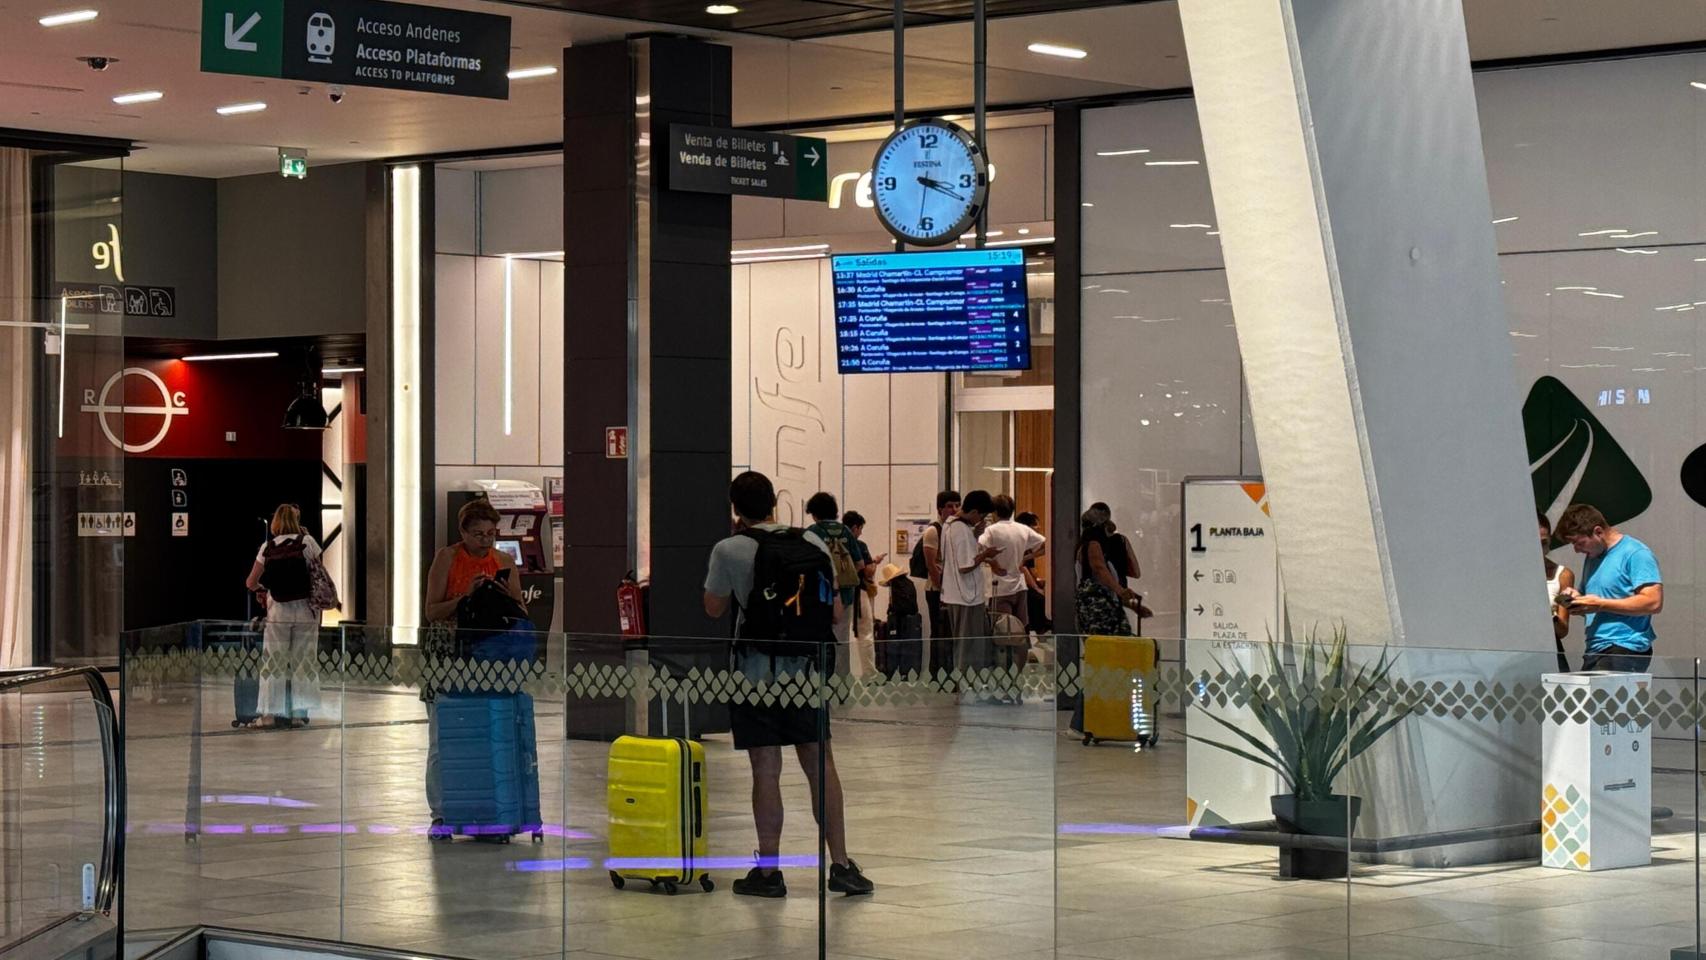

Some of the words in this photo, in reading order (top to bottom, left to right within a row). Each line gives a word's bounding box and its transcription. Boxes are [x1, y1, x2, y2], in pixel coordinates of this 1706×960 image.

[357, 17, 401, 36] Acceso
[405, 22, 461, 43] Andenes
[356, 43, 402, 62] Acceso
[406, 48, 482, 71] Plataformas
[355, 66, 388, 79] ACCESS
[391, 69, 402, 80] TO
[405, 70, 456, 85] PLATFORMS
[684, 133, 713, 148] Venta
[715, 136, 728, 149] de
[731, 137, 767, 153] Billetes
[918, 134, 938, 149] 12
[680, 151, 712, 166] Venda
[714, 154, 727, 167] de
[730, 156, 767, 171] Billetes
[913, 160, 942, 169] FESTINA
[730, 176, 750, 186] TICKET
[751, 178, 767, 187] SALES
[884, 176, 897, 191] 9
[959, 174, 972, 189] 3
[920, 216, 934, 231] 6
[856, 258, 887, 267] Salidas
[988, 250, 1012, 260] 15:19
[1011, 280, 1017, 288] 2
[858, 300, 880, 308] Madrid
[1013, 310, 1019, 318] 4
[1014, 325, 1020, 333] 4
[1190, 523, 1206, 552] 1
[1209, 527, 1243, 537] PLANTA
[1243, 528, 1265, 537] BAJA
[1213, 622, 1239, 630] SALIDA
[1212, 631, 1237, 639] PLAZA
[1238, 631, 1248, 639] DE
